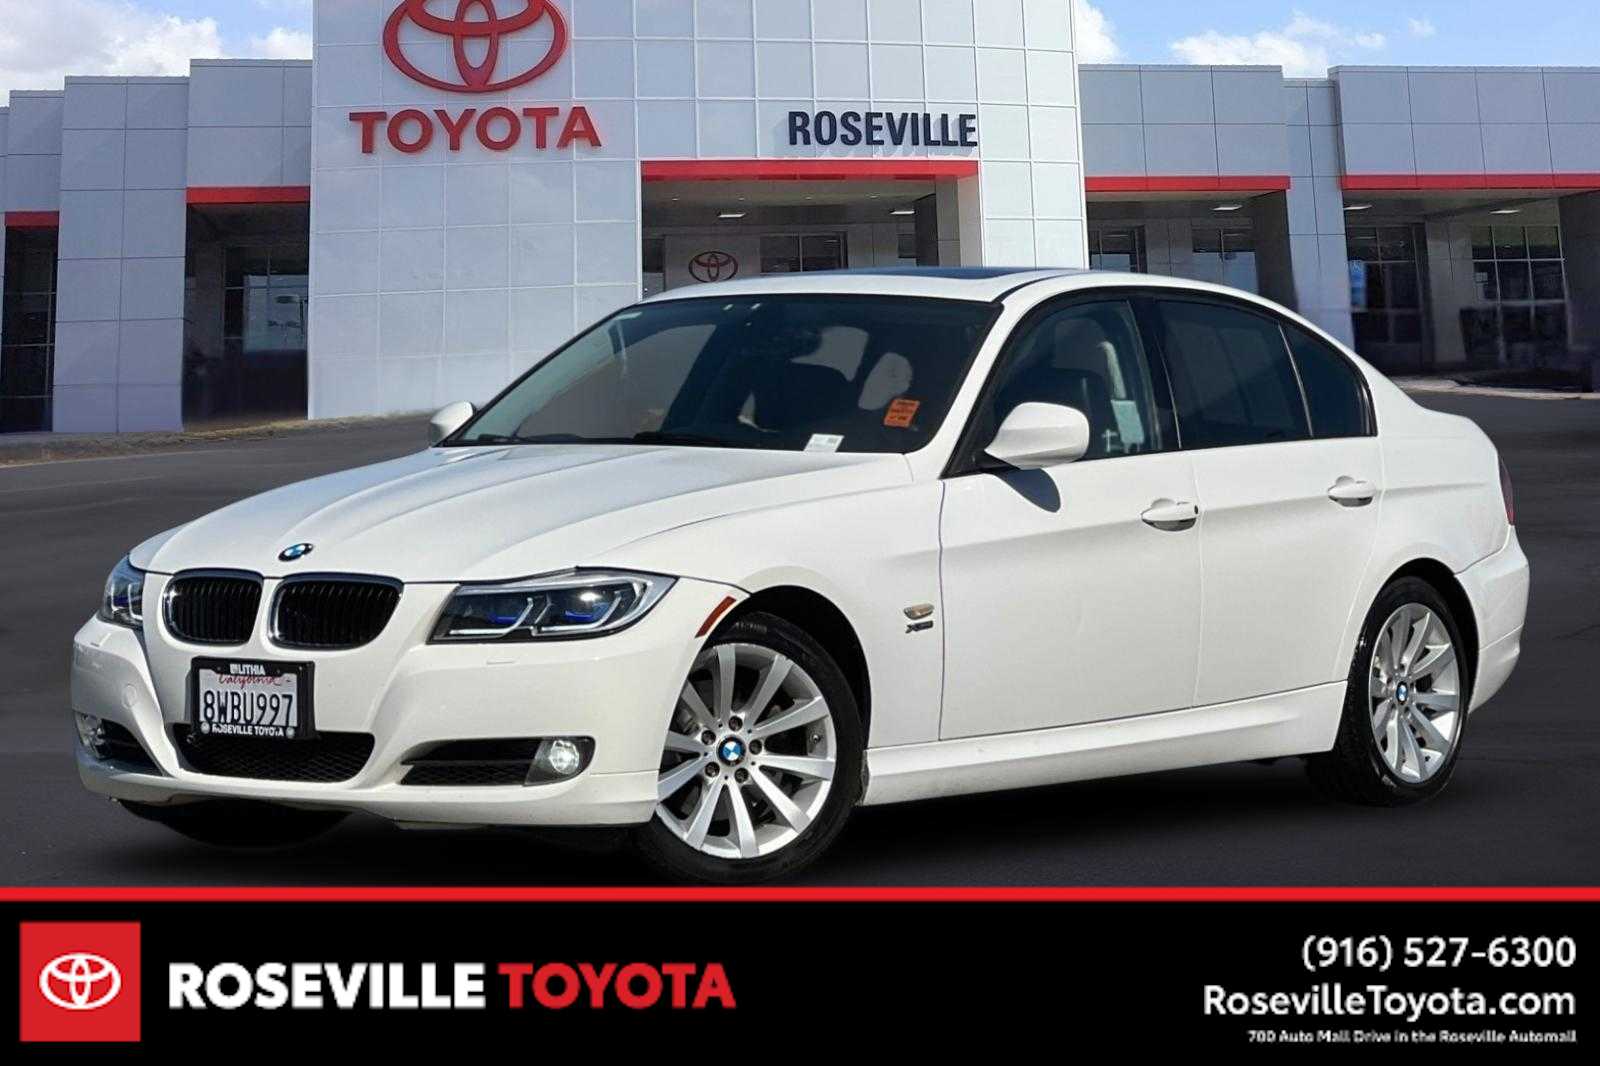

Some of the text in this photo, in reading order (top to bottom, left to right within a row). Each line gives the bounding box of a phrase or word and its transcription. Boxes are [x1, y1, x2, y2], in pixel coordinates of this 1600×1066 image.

[349, 106, 602, 154] TOYOTA
[788, 111, 978, 147] ROSEVILLE
[238, 664, 266, 675] LITHIA
[203, 690, 293, 726] 8WBU997
[211, 724, 253, 735] ROSEVILLE
